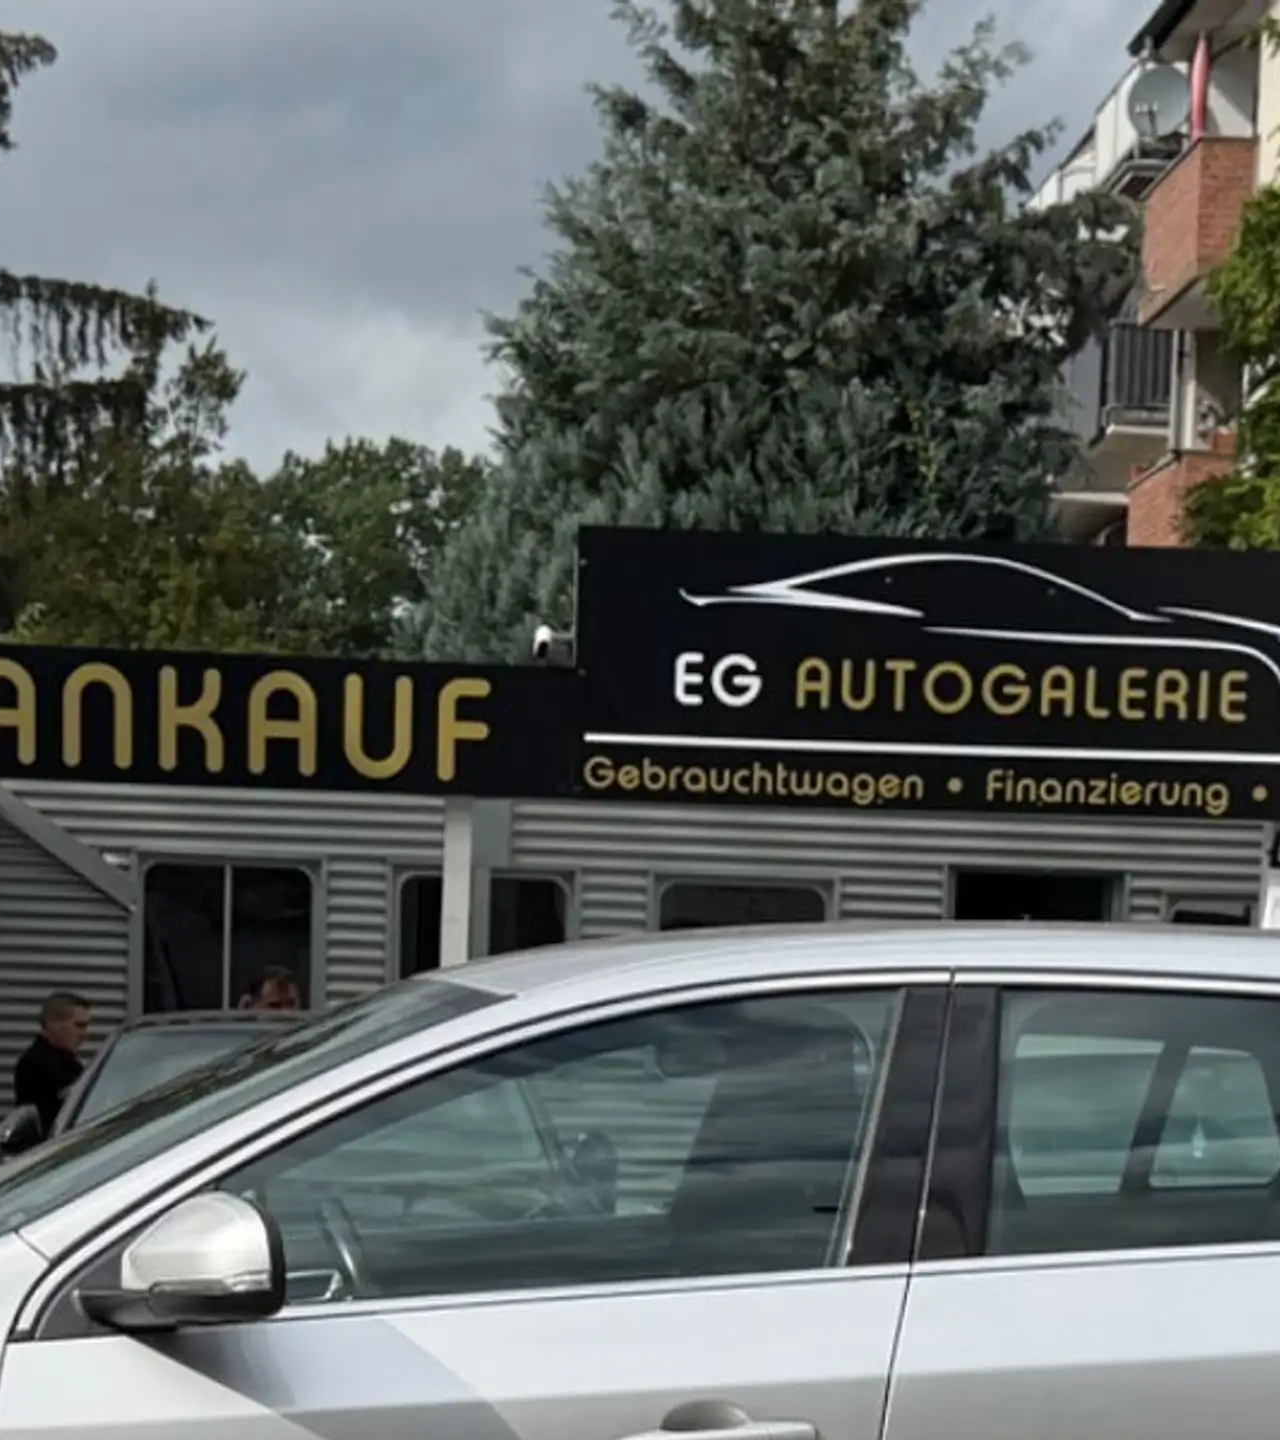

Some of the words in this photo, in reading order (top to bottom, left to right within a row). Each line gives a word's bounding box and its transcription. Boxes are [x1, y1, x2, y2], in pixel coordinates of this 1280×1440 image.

[674, 651, 762, 707] EG
[796, 658, 1249, 722] AUTOGALERIE
[584, 756, 923, 804] Gebrauchtwagen
[986, 769, 1228, 815] Finanzierung
